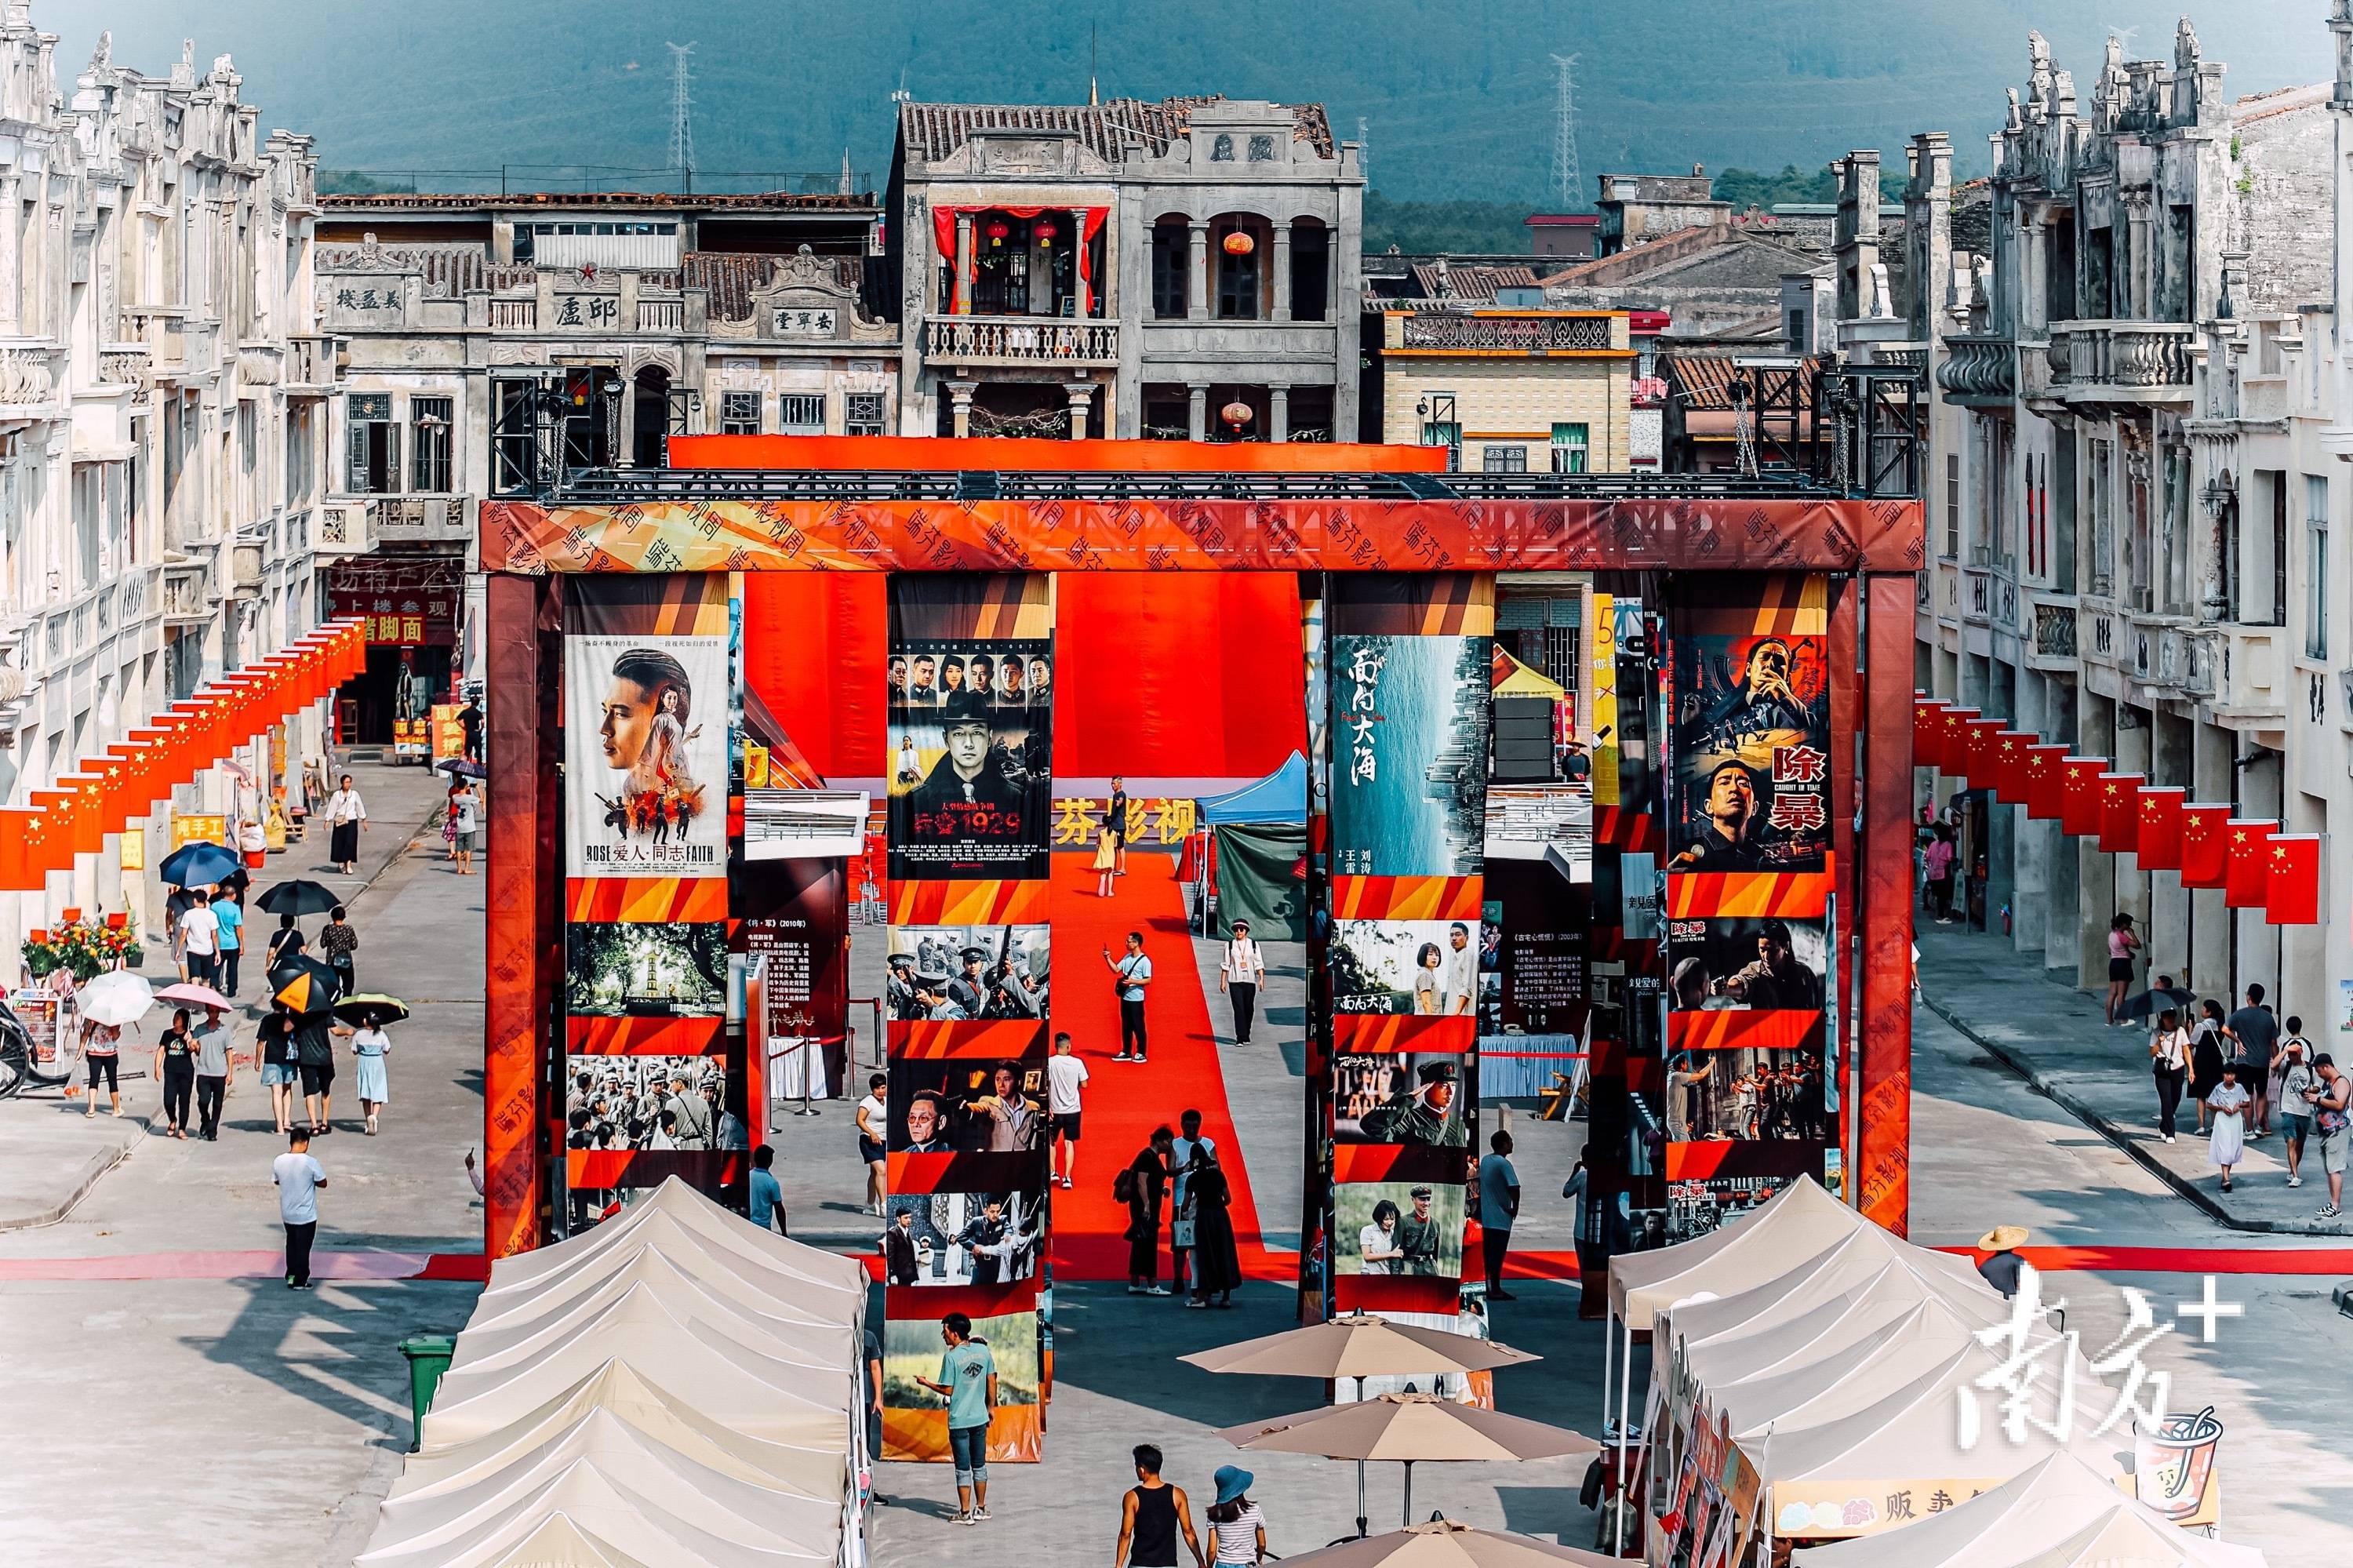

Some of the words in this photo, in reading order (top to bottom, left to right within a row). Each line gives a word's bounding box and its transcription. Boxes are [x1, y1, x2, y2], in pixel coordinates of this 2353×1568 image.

[1348, 648, 1377, 787] 面向大海
[587, 846, 610, 861] ROSE
[686, 846, 713, 861] FAITH
[1345, 849, 1356, 874] 王雷
[1361, 849, 1372, 874] 刘涛
[1671, 921, 1706, 935] 除暴
[1340, 995, 1393, 1013] 面向大海
[1668, 1184, 1707, 1199] 除暴
